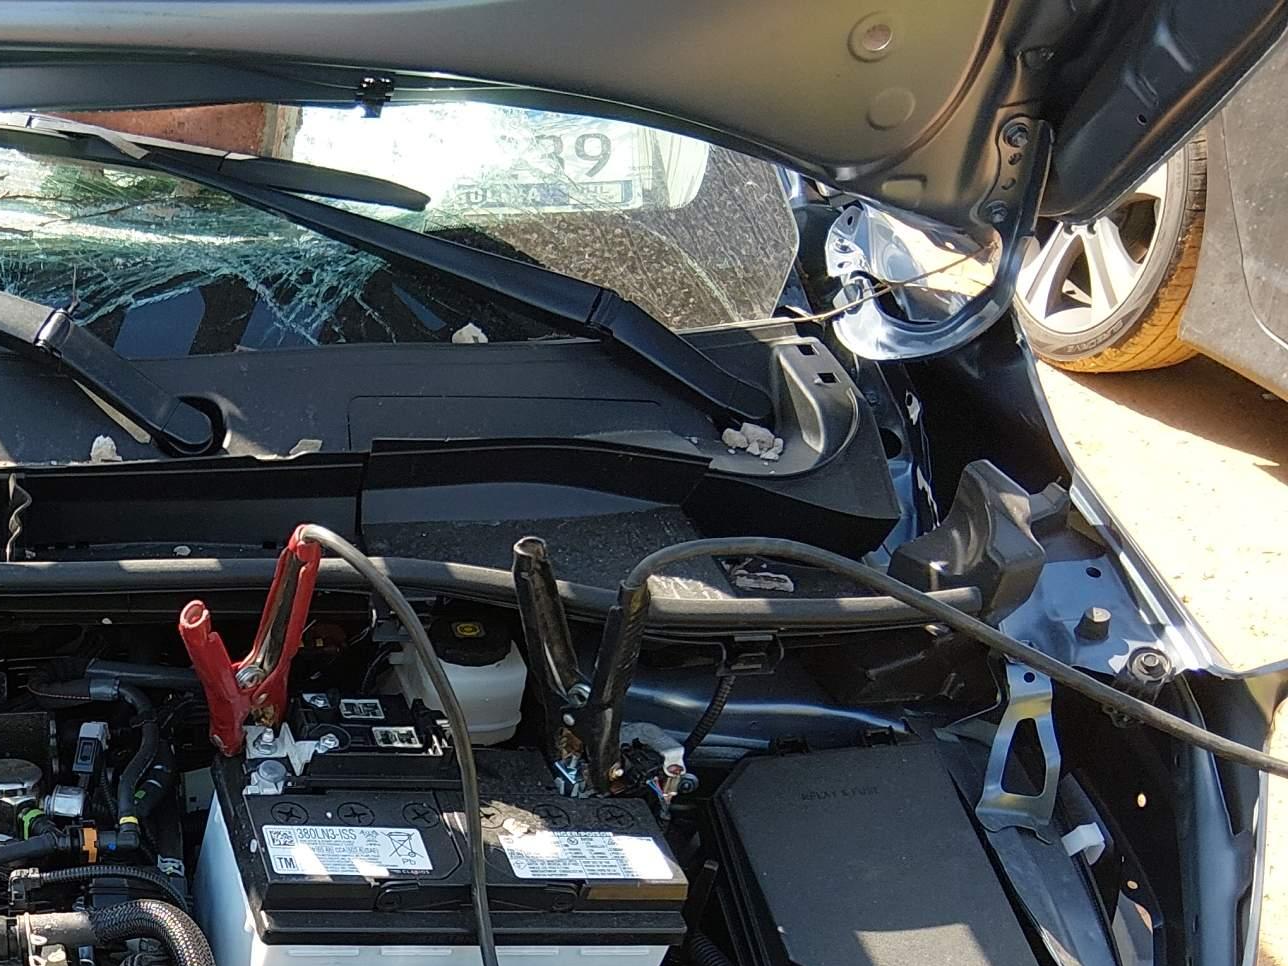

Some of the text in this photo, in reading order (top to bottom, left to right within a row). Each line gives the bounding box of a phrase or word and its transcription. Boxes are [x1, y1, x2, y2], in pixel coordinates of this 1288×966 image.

[297, 828, 357, 840] 380LN3-ISS
[277, 856, 296, 869] TM
[401, 857, 416, 866] Pb
